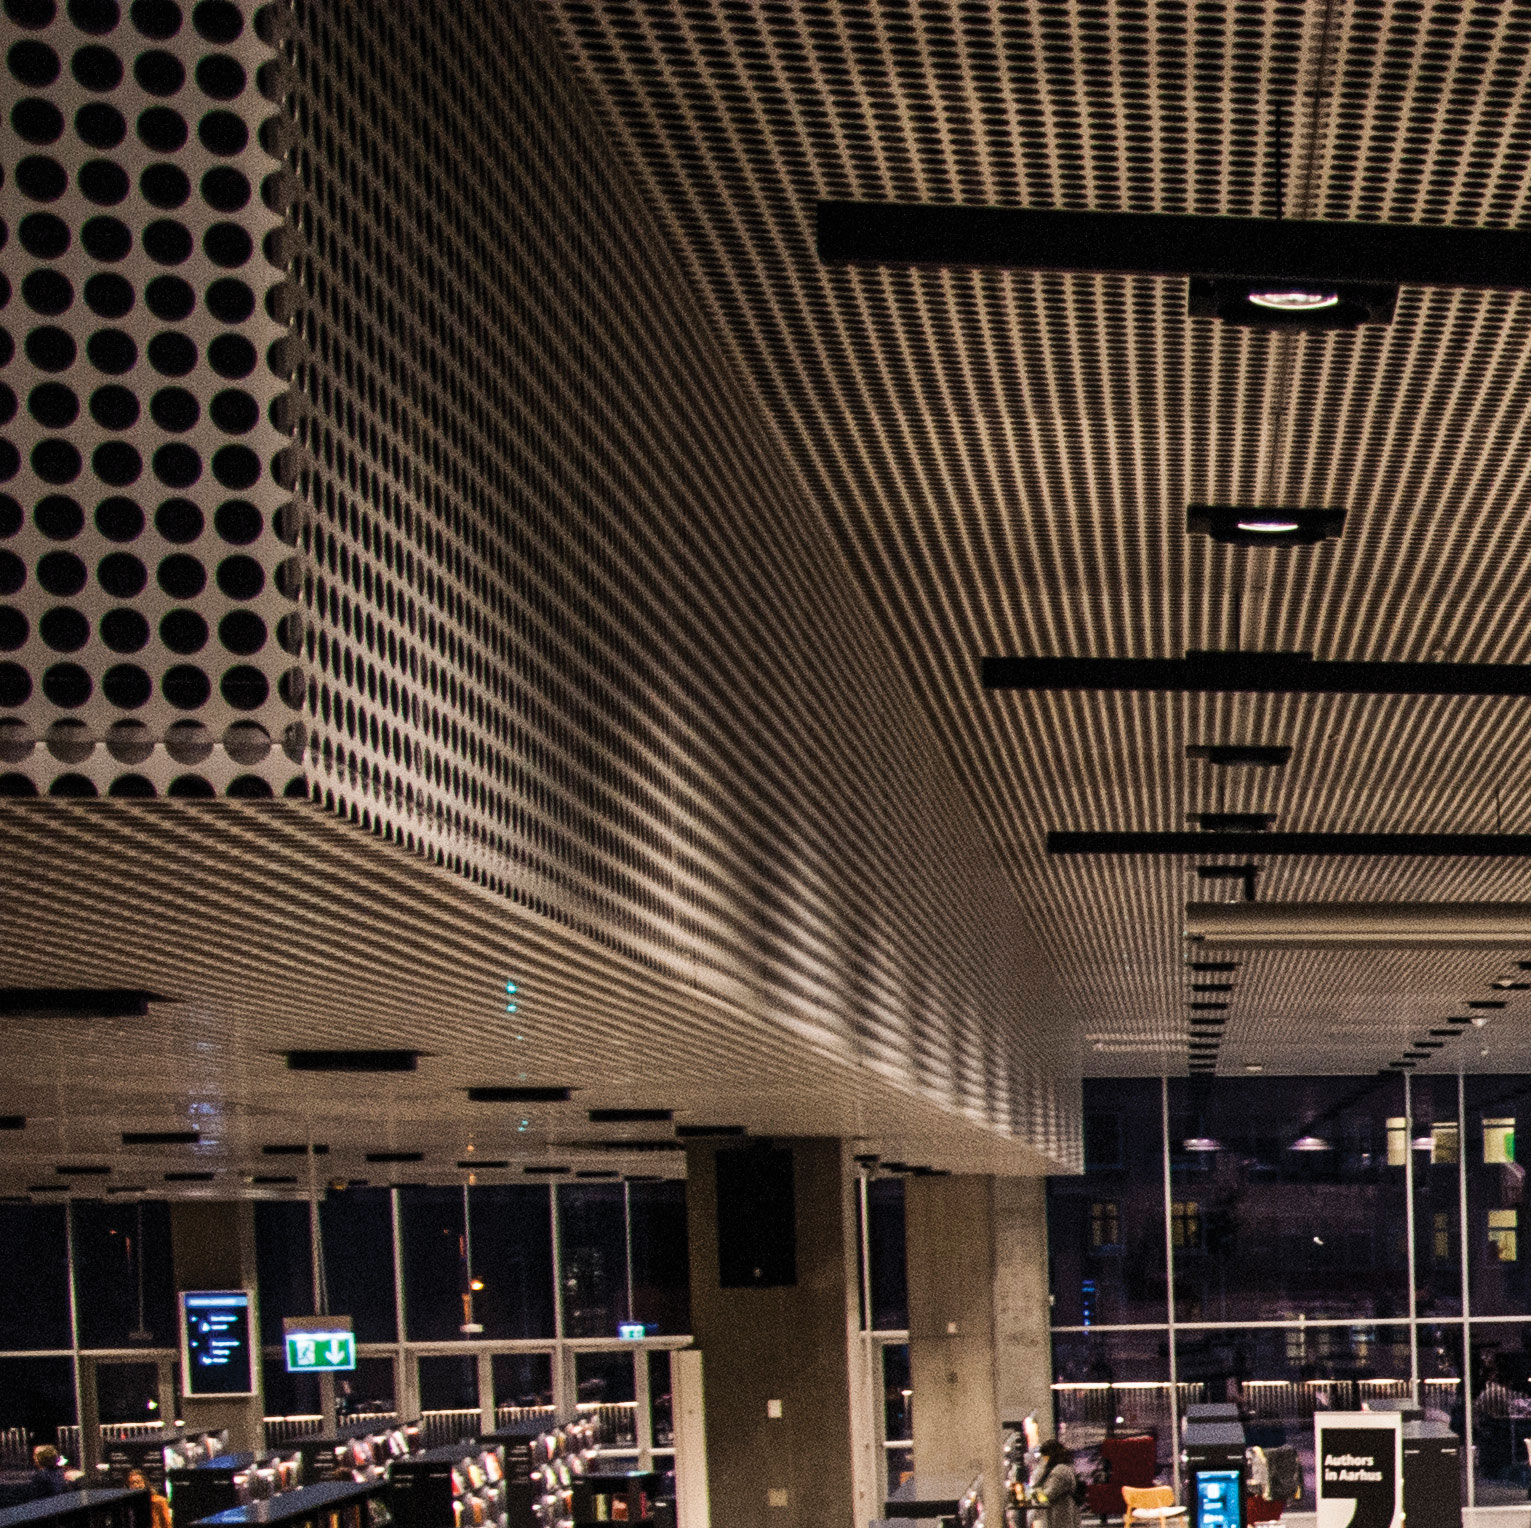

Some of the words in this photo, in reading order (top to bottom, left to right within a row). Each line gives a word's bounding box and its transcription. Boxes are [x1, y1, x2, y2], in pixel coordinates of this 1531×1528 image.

[1324, 1453, 1374, 1467] Authors
[1324, 1468, 1338, 1481] in
[1339, 1468, 1382, 1481] Aarhus
